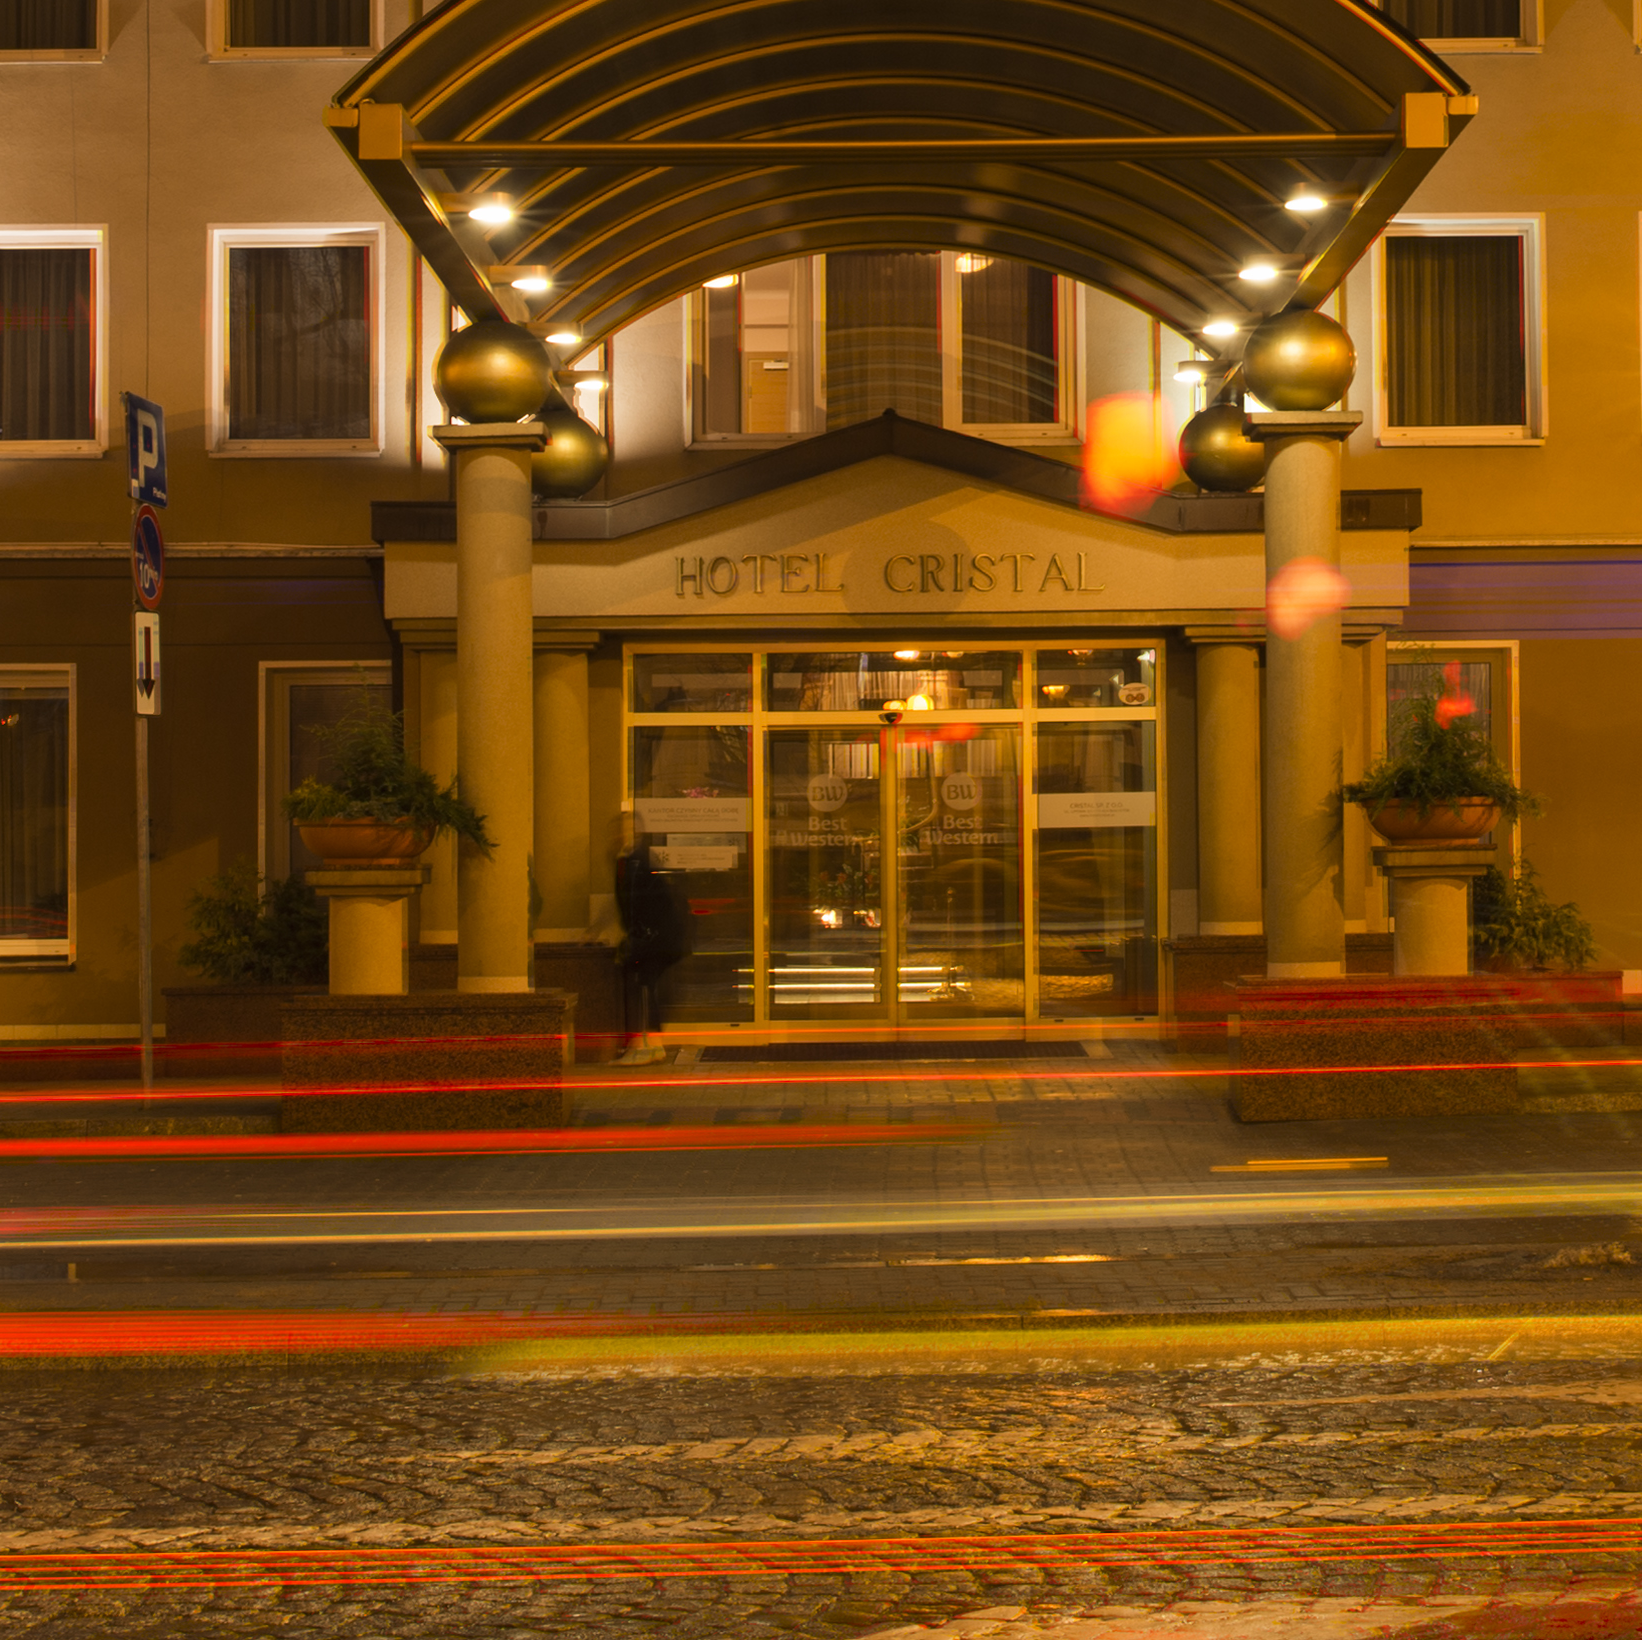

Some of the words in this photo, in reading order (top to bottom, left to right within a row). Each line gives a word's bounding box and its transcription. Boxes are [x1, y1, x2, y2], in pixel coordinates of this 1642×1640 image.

[137, 408, 159, 488] P
[674, 553, 845, 597] HOTEL
[884, 552, 1106, 593] CRISTAL
[811, 785, 844, 802] BW
[945, 784, 978, 800] BW
[808, 816, 848, 832] Best
[943, 814, 983, 830] Best
[791, 832, 863, 847] Western
[928, 830, 1000, 845] Western
